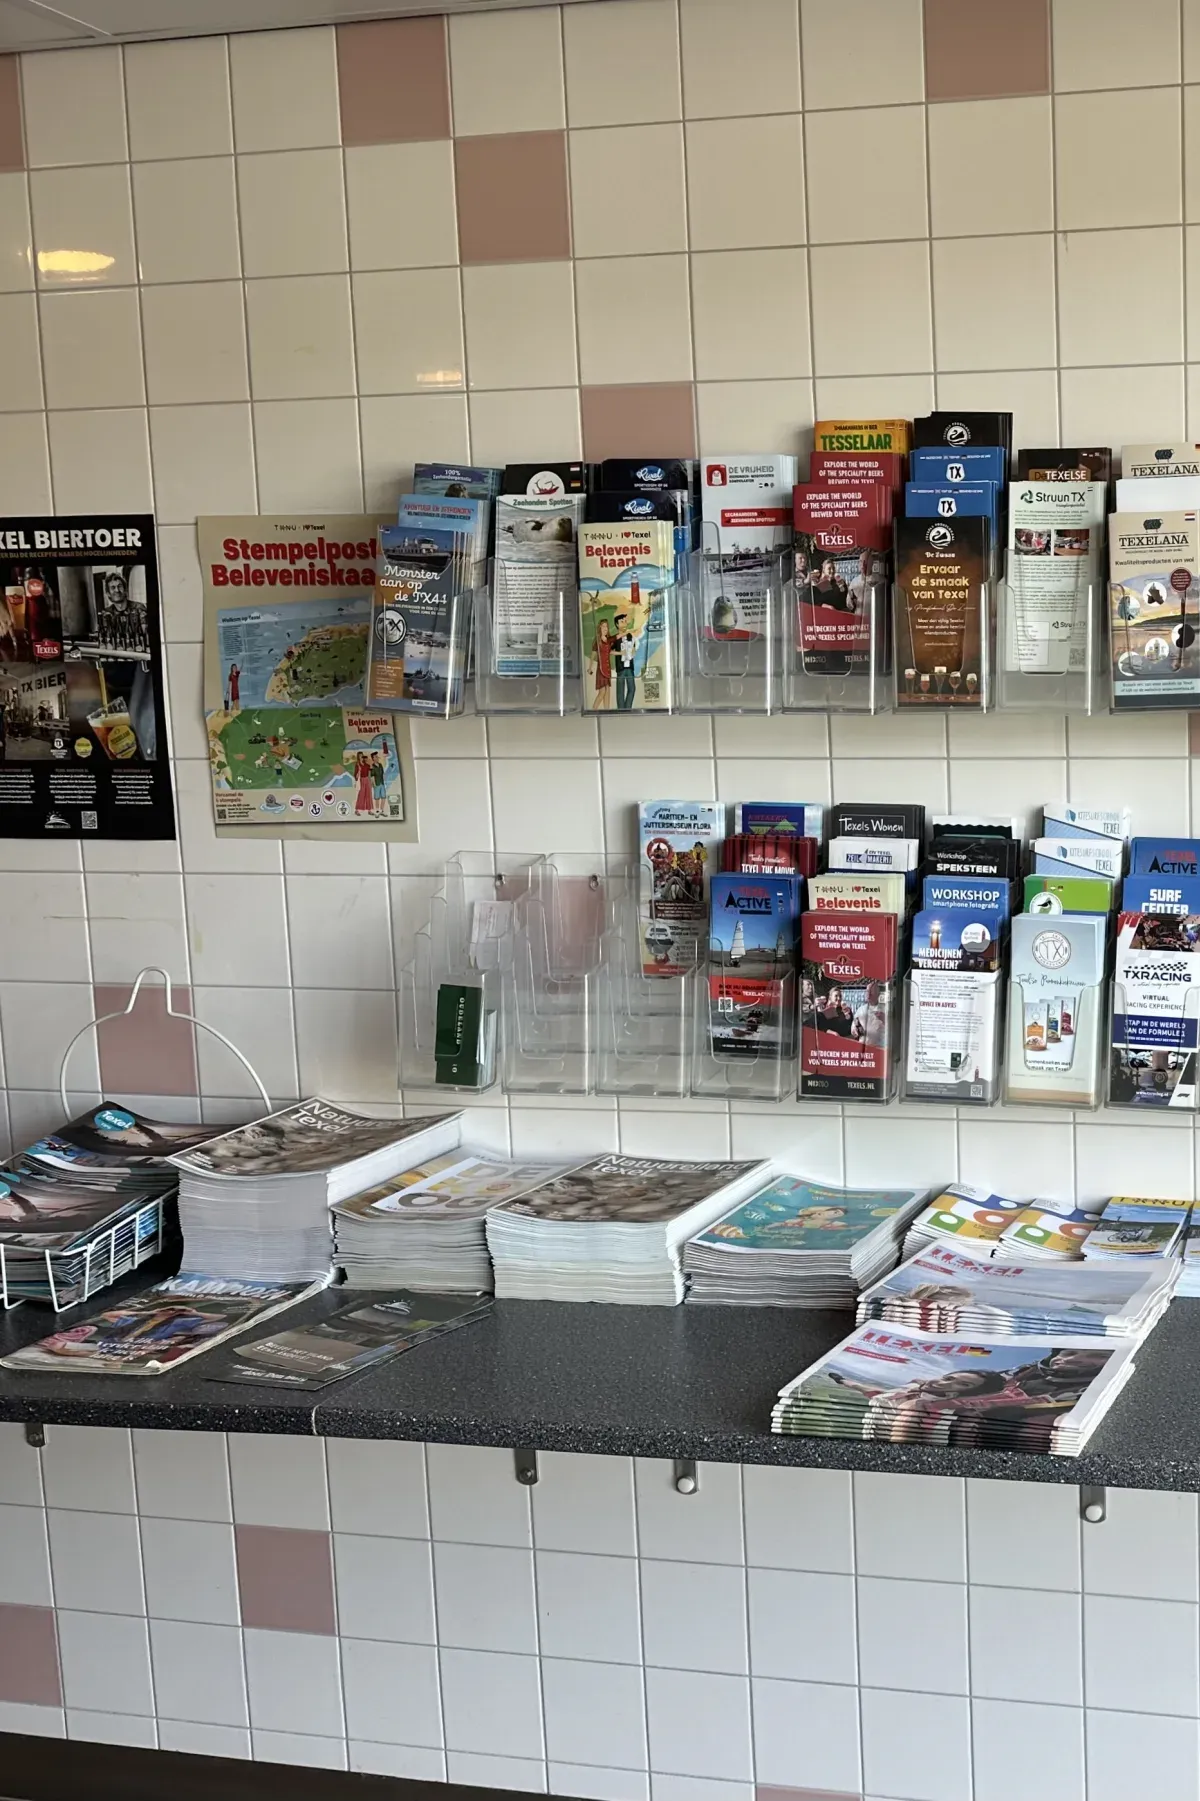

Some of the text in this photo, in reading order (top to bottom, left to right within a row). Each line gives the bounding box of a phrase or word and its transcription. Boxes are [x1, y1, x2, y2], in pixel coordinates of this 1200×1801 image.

[820, 433, 892, 451] TESSELAAR
[949, 466, 962, 480] TX
[1044, 470, 1086, 480] TEXELSE
[1131, 466, 1200, 477] TEXELANA
[806, 492, 862, 500] EXPLORE THE WORLD
[1036, 492, 1086, 502] Struun TX
[548, 498, 573, 507] Spotten
[941, 501, 953, 514] TX
[34, 528, 142, 549] BIERTOER
[632, 530, 651, 539] Texel
[818, 532, 854, 546] TEXELS
[1119, 534, 1189, 547] TEXELANA
[585, 543, 651, 557] Belevenis
[600, 556, 637, 568] kaart
[1115, 558, 1172, 566] Kwaliteitsproducten
[384, 564, 440, 580] Monster
[920, 564, 961, 574] Ervaar
[912, 576, 969, 588] de smaak
[394, 590, 409, 602] de
[912, 590, 968, 600] van Texel
[34, 671, 66, 690] BIER
[348, 718, 388, 726] Belevenis
[358, 725, 380, 734] kaart
[839, 817, 904, 832] Texels Wonen
[1103, 823, 1120, 834] TEXEL
[867, 856, 892, 864] MAKERIJ
[936, 852, 966, 860] Workshop
[936, 863, 997, 874] SPEKSTEEN
[1095, 860, 1113, 872] TEXEL
[1149, 856, 1198, 874] ACTIVE
[725, 890, 772, 910] ACTIVE
[931, 888, 1000, 902] WORKSHOP
[1150, 888, 1182, 902] SURF
[816, 896, 881, 909] Belevenis
[918, 948, 962, 959] MEDICIJNEN
[826, 962, 860, 976] TEXELS
[918, 959, 959, 970] VERGETEN?
[1123, 970, 1192, 982] TXRACING
[1142, 994, 1169, 1002] VIRTUAL
[847, 1081, 875, 1090] TEXELS.NL
[101, 1110, 131, 1129] Texel
[290, 1109, 350, 1133] Texel
[592, 1162, 652, 1176] Texel
[601, 1155, 750, 1171] Natuureiland
